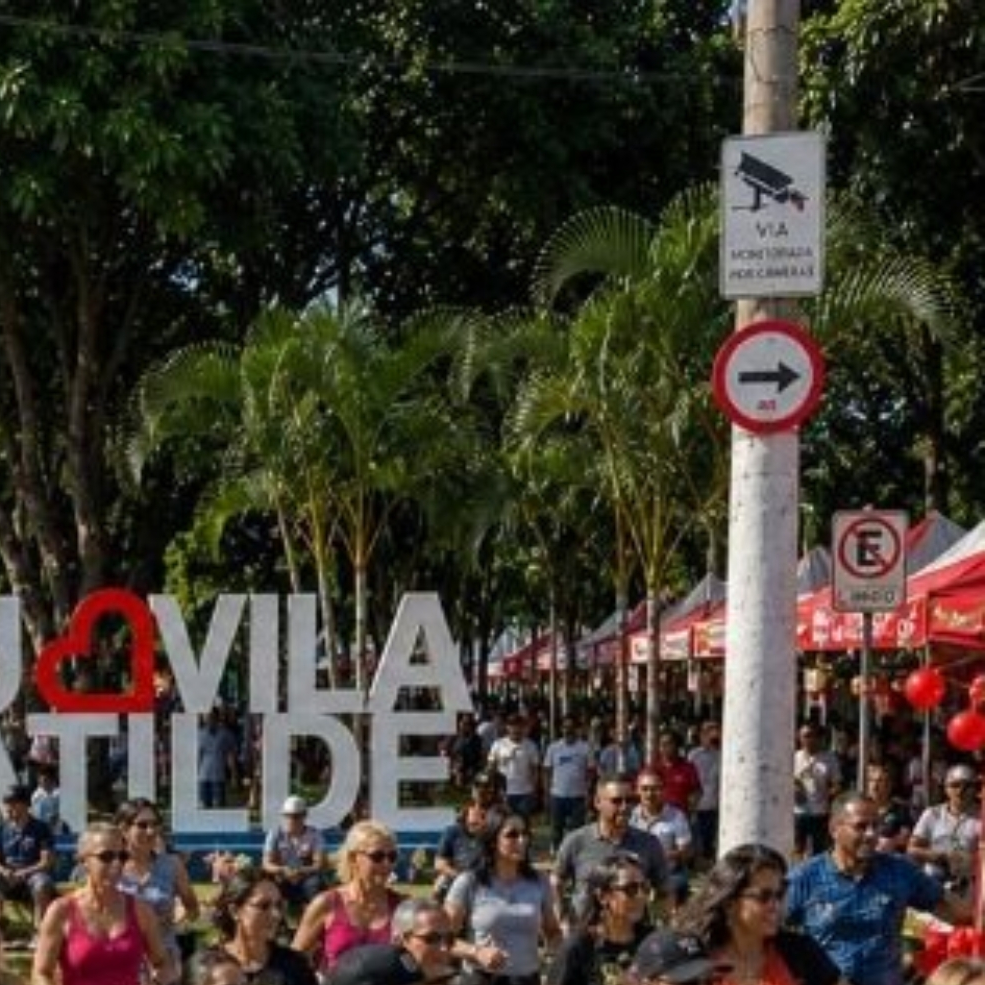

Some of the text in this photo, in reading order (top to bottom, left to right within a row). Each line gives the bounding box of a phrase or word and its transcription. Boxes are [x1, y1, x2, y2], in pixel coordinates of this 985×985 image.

[756, 222, 788, 238] VIA
[856, 530, 882, 566] E
[147, 592, 476, 714] VILA
